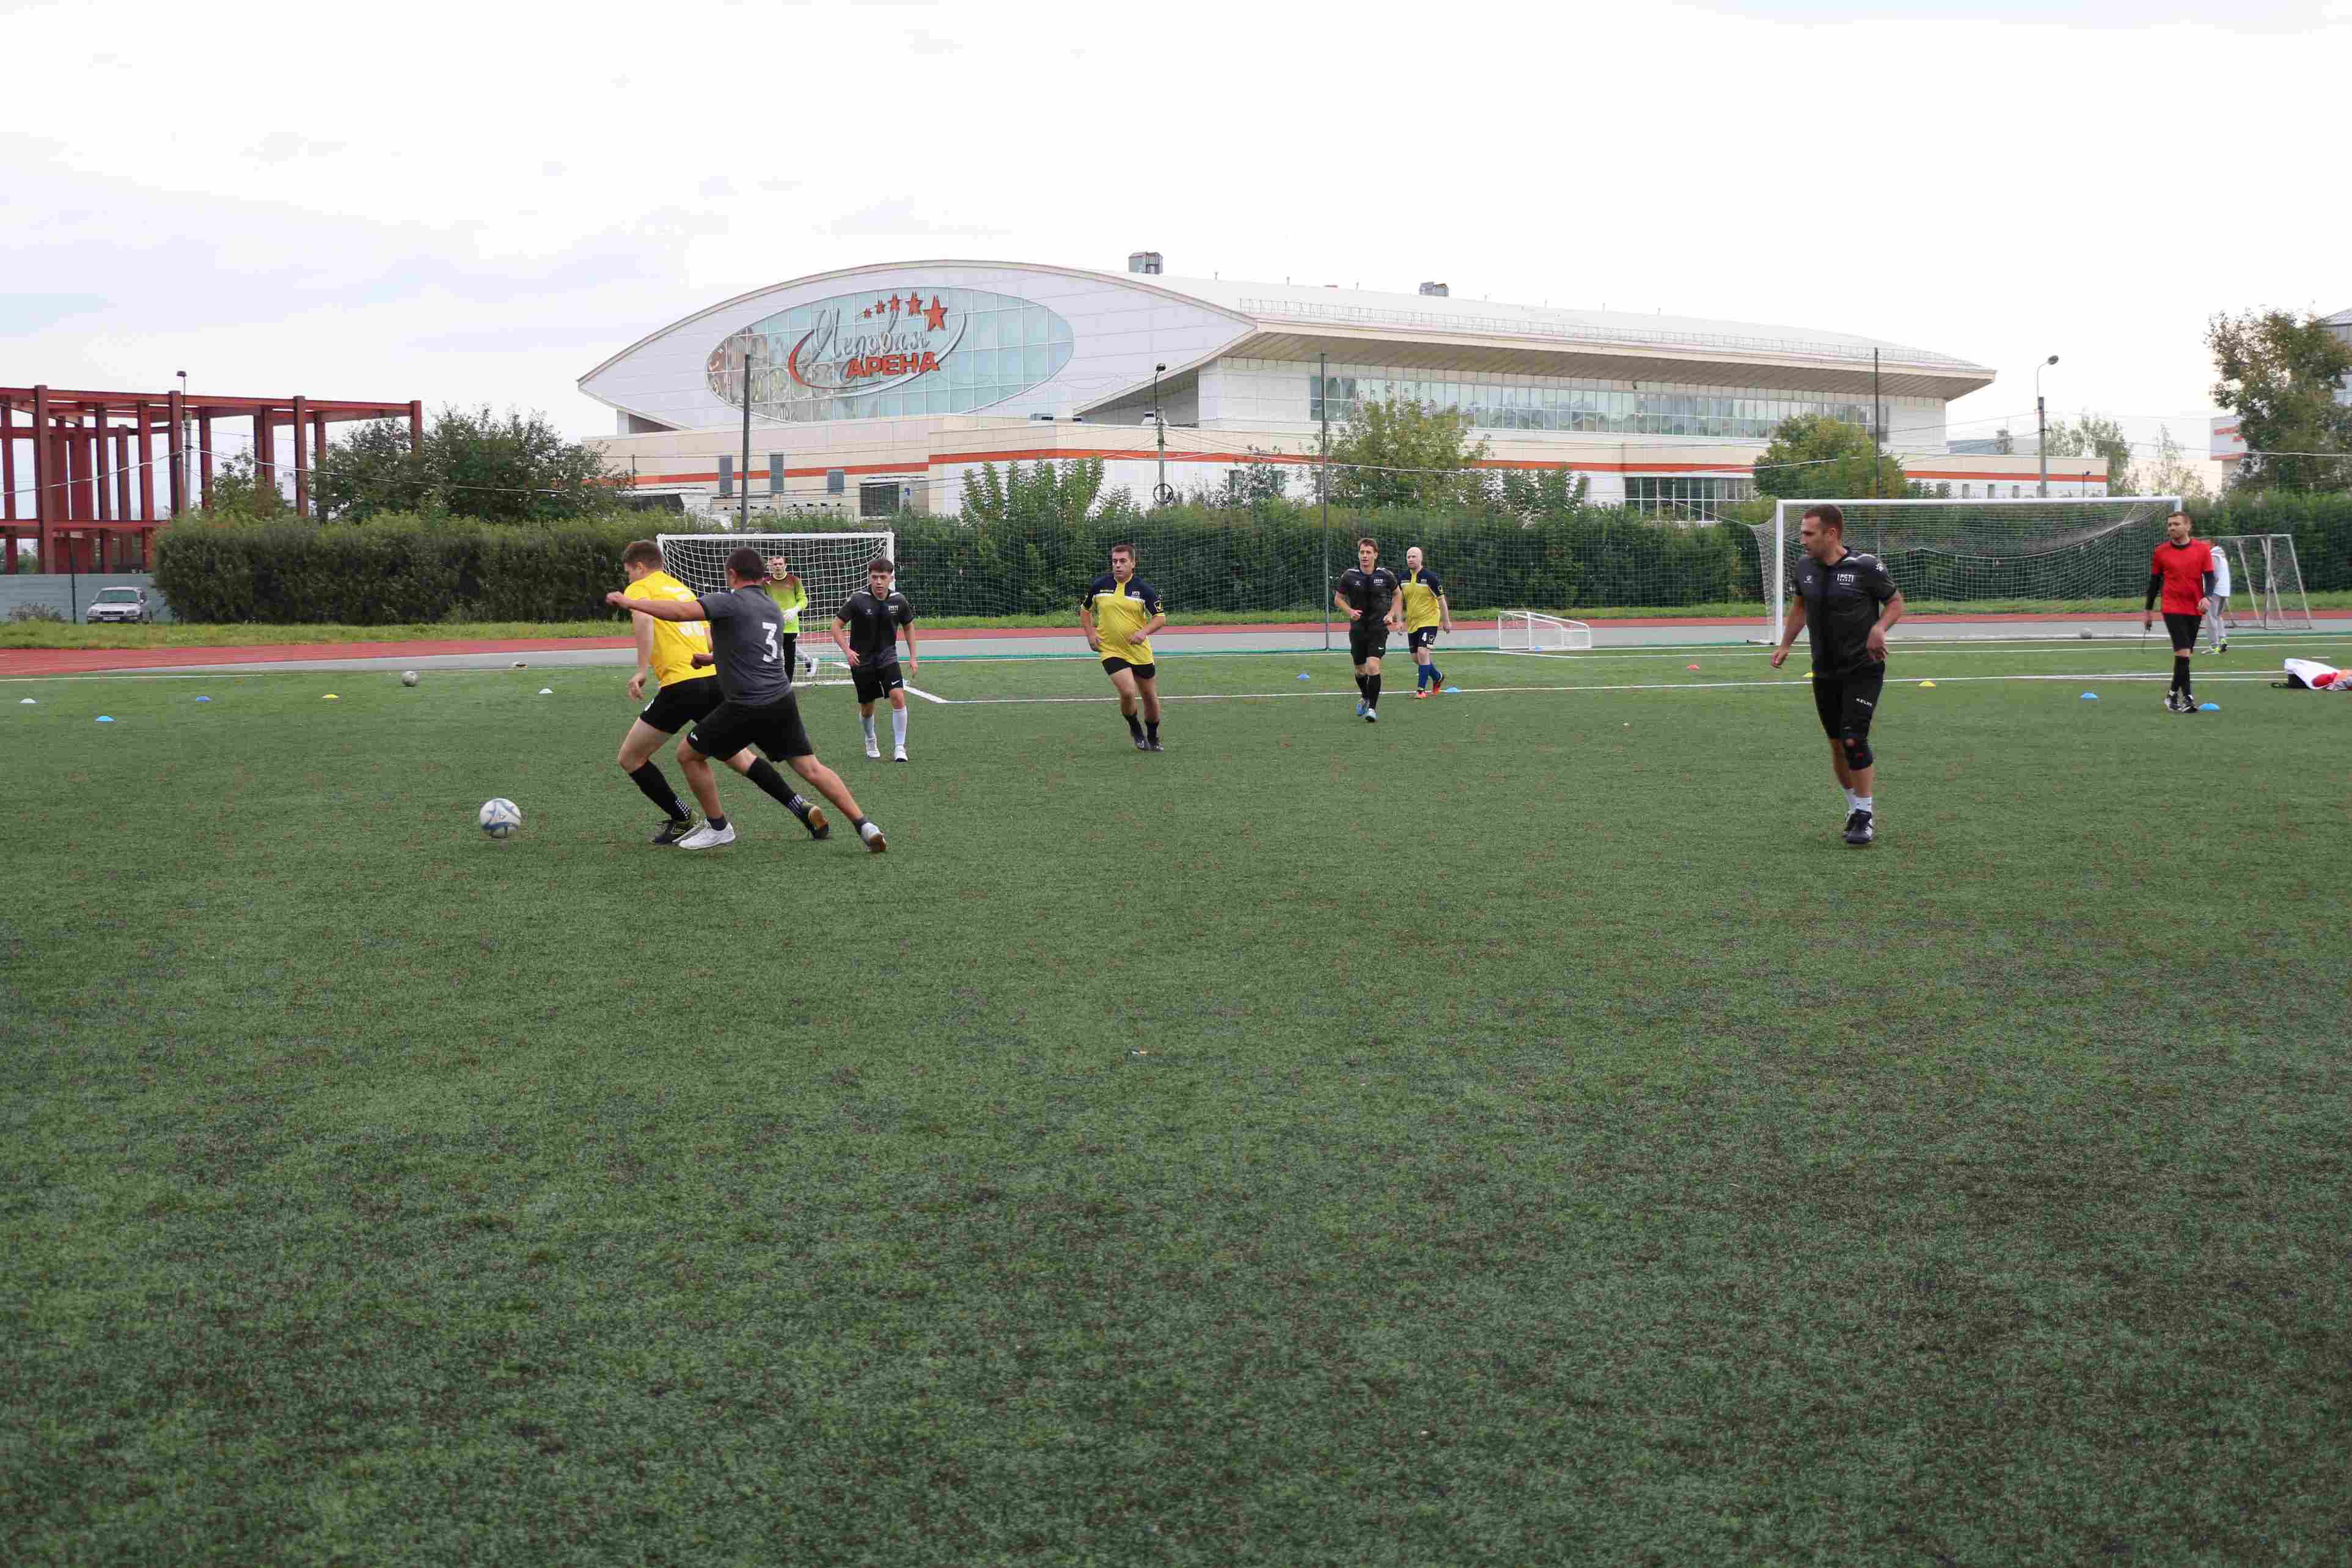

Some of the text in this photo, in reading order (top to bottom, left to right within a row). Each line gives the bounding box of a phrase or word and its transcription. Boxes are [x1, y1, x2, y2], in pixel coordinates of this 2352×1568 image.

[846, 351, 940, 379] АРЕНА
[762, 621, 778, 662] 3
[1421, 632, 1427, 641] 4
